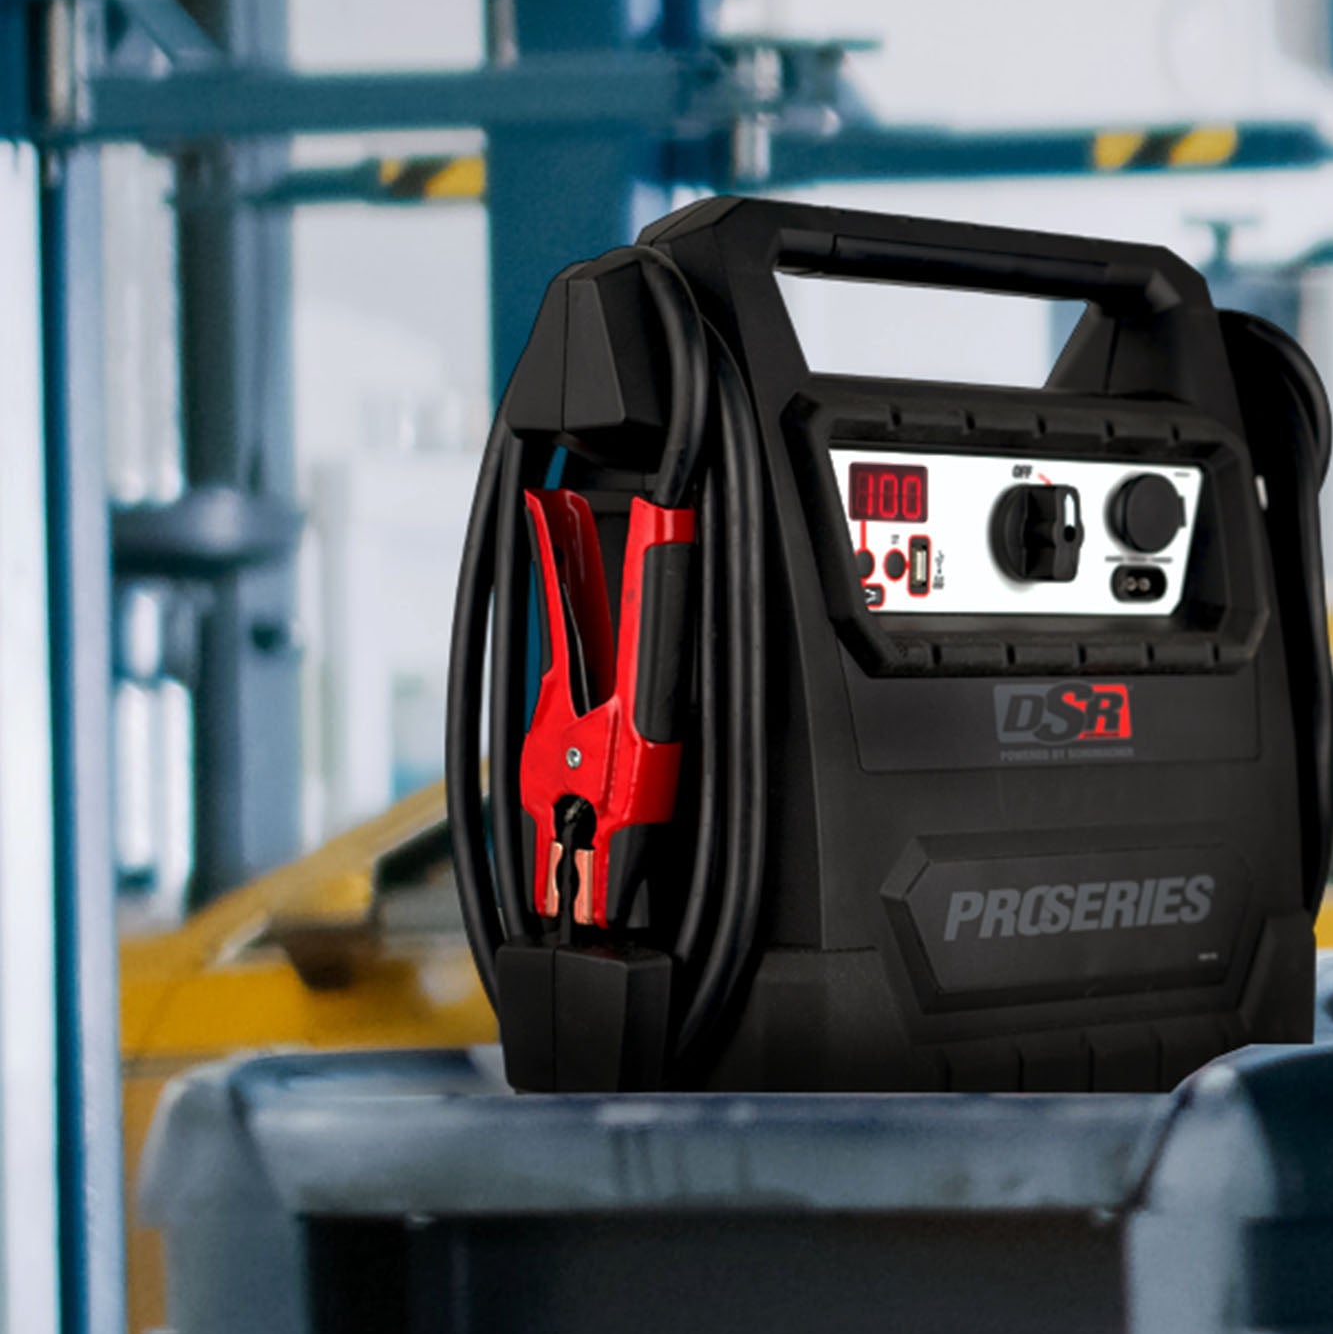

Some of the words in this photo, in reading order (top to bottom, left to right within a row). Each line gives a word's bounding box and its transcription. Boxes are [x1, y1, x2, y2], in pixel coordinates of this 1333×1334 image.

[1012, 464, 1033, 479] OFF
[866, 472, 922, 520] 100
[1002, 680, 1124, 743] DSR
